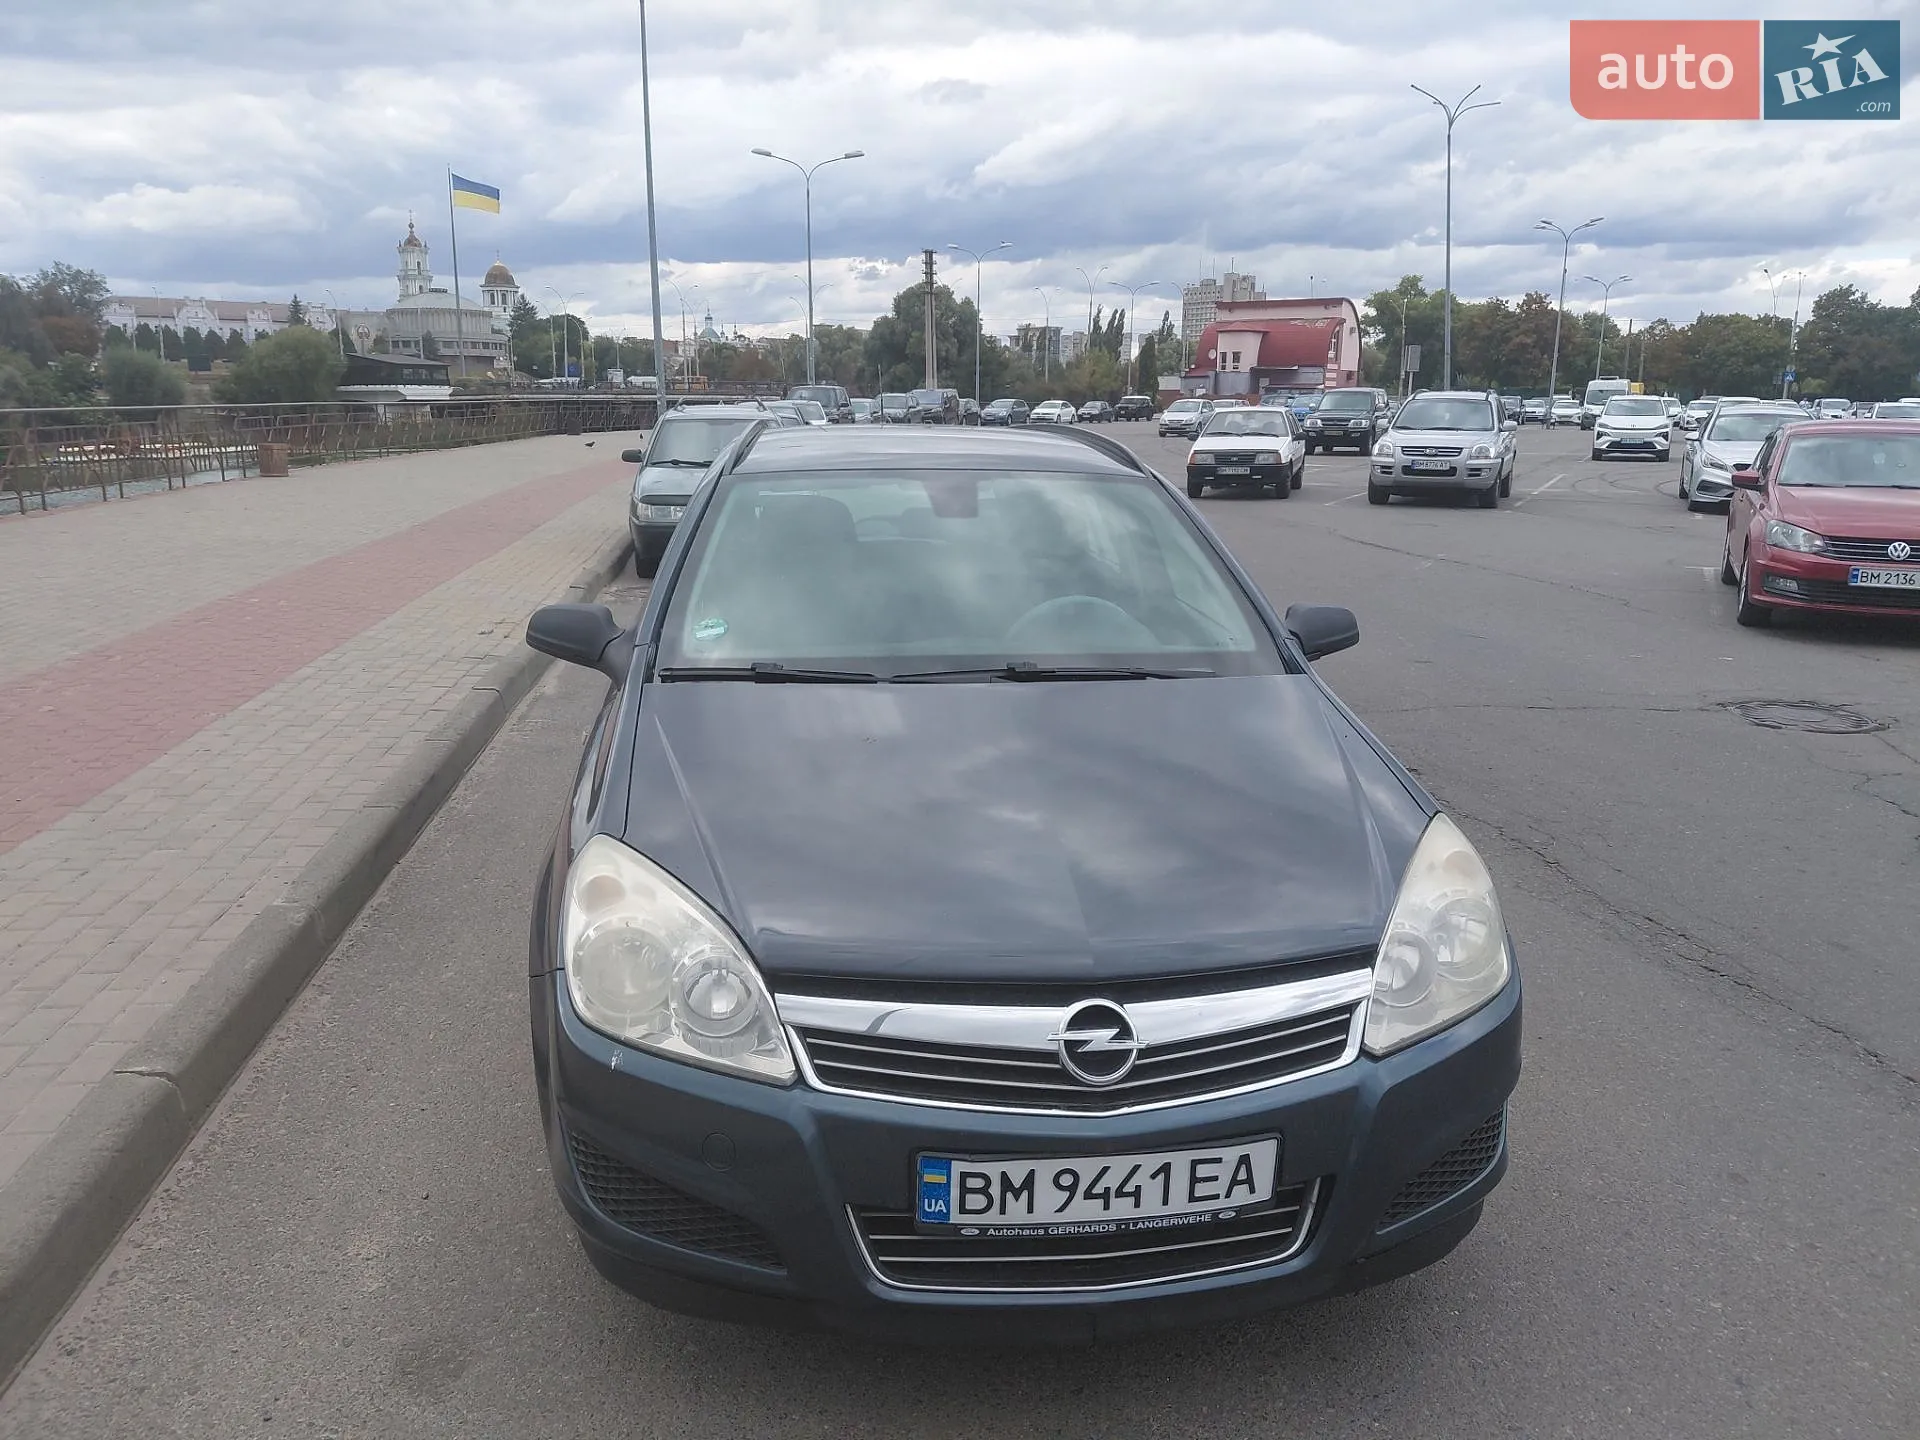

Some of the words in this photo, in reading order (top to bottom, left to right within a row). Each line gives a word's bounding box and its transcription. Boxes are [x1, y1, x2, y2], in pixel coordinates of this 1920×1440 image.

[1860, 571, 1880, 584] BM
[1884, 572, 1916, 585] 2136
[958, 1168, 1036, 1215] BM
[1052, 1161, 1172, 1213] 9441
[1188, 1153, 1256, 1203] EA
[924, 1198, 947, 1213] UA
[987, 1227, 1045, 1236] Autohaus
[1048, 1224, 1117, 1235] GERHARDS
[1129, 1213, 1212, 1230] LANGERWEHE
